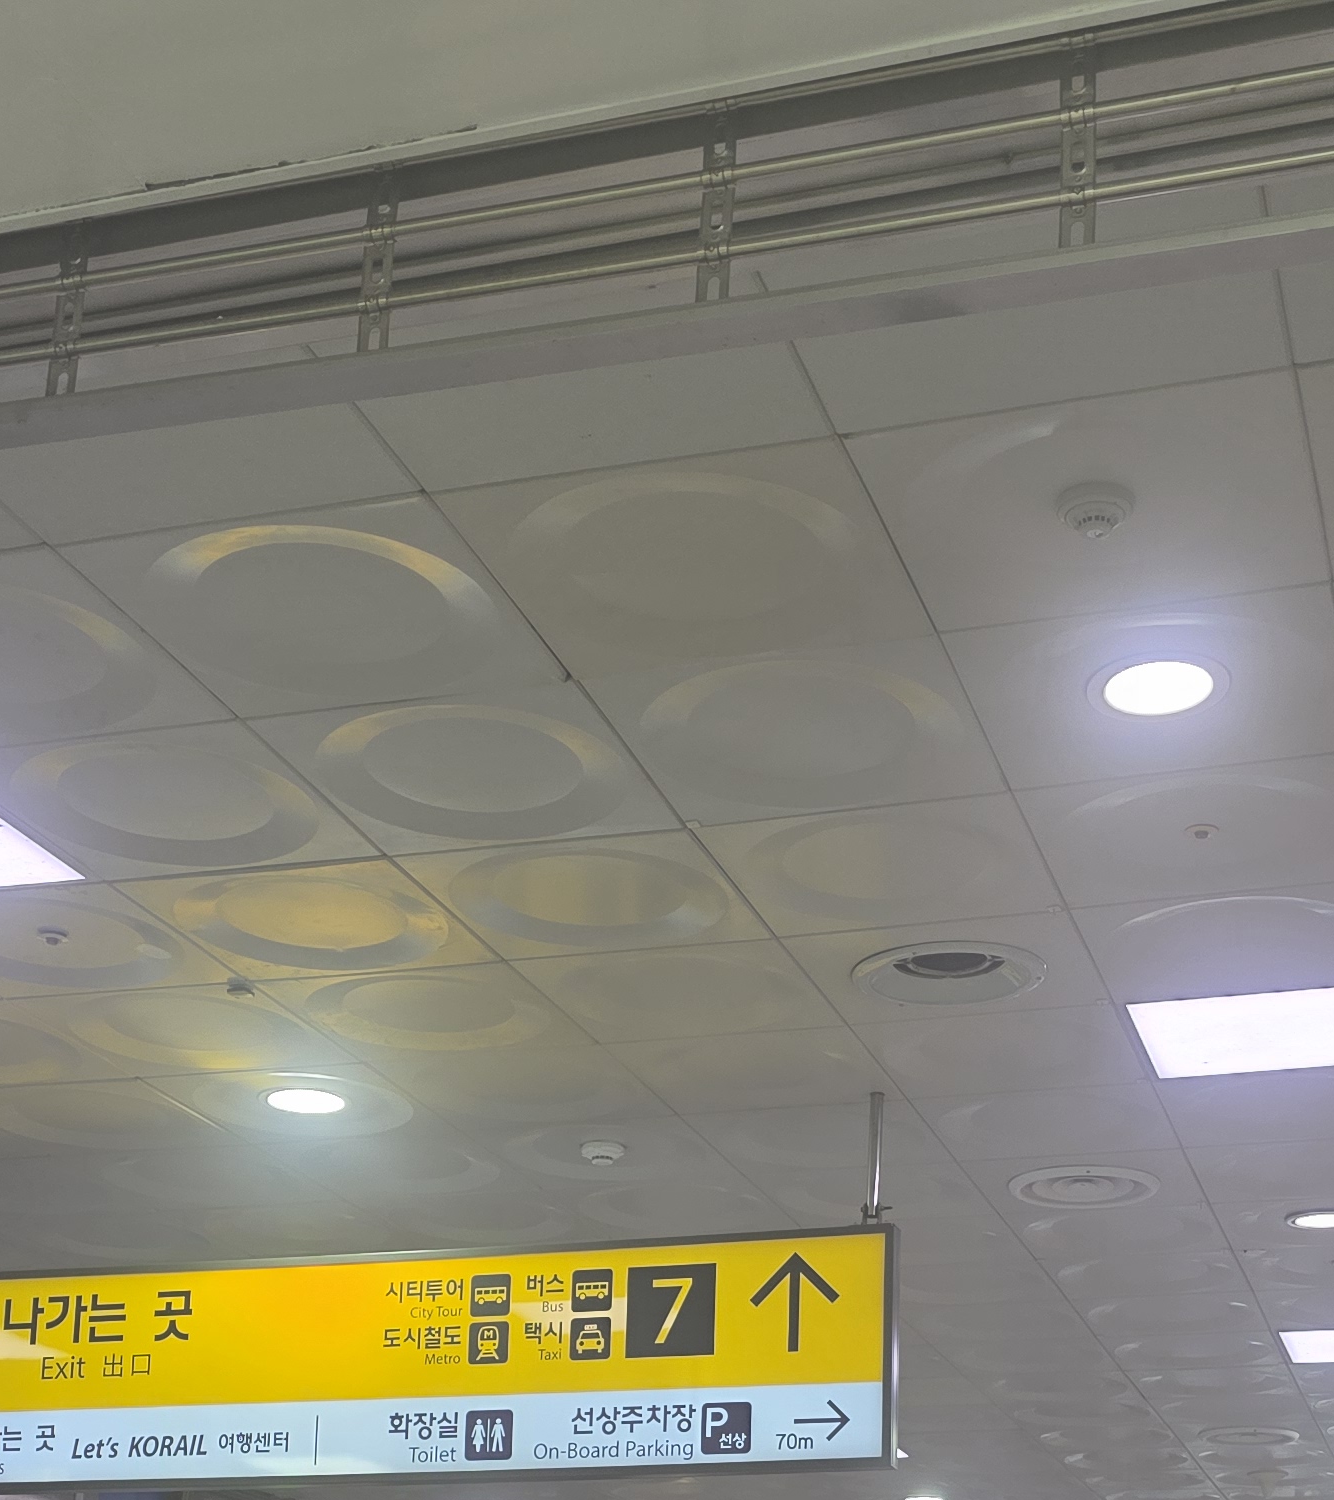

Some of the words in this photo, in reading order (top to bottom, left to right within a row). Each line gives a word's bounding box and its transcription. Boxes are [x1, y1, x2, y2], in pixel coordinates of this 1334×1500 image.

[384, 1278, 465, 1303] 시티투어
[526, 1273, 565, 1297] 버스
[1, 1292, 128, 1345] 나가는
[153, 1289, 194, 1342] 곳
[409, 1306, 435, 1321] City
[436, 1305, 463, 1319] Tour
[541, 1300, 565, 1314] Bus
[651, 1277, 694, 1345] 7
[382, 1325, 463, 1350] 도시철도
[523, 1321, 565, 1345] 택시
[40, 1354, 86, 1380] Exit
[101, 1352, 152, 1379] 出口
[424, 1352, 462, 1366] Metro
[537, 1347, 563, 1361] Taxi
[388, 1411, 460, 1440] 화장실
[570, 1403, 697, 1436] 선상주차장
[706, 1407, 730, 1438] P
[34, 1423, 57, 1452] 곳
[70, 1436, 119, 1460] Let's
[127, 1434, 208, 1458] KORAIL
[217, 1430, 290, 1455] 여행센터
[533, 1440, 620, 1461] On-Board
[625, 1438, 695, 1460] Parking
[718, 1431, 747, 1449] 선상
[775, 1433, 815, 1451] 70m
[408, 1445, 457, 1463] Toilet
